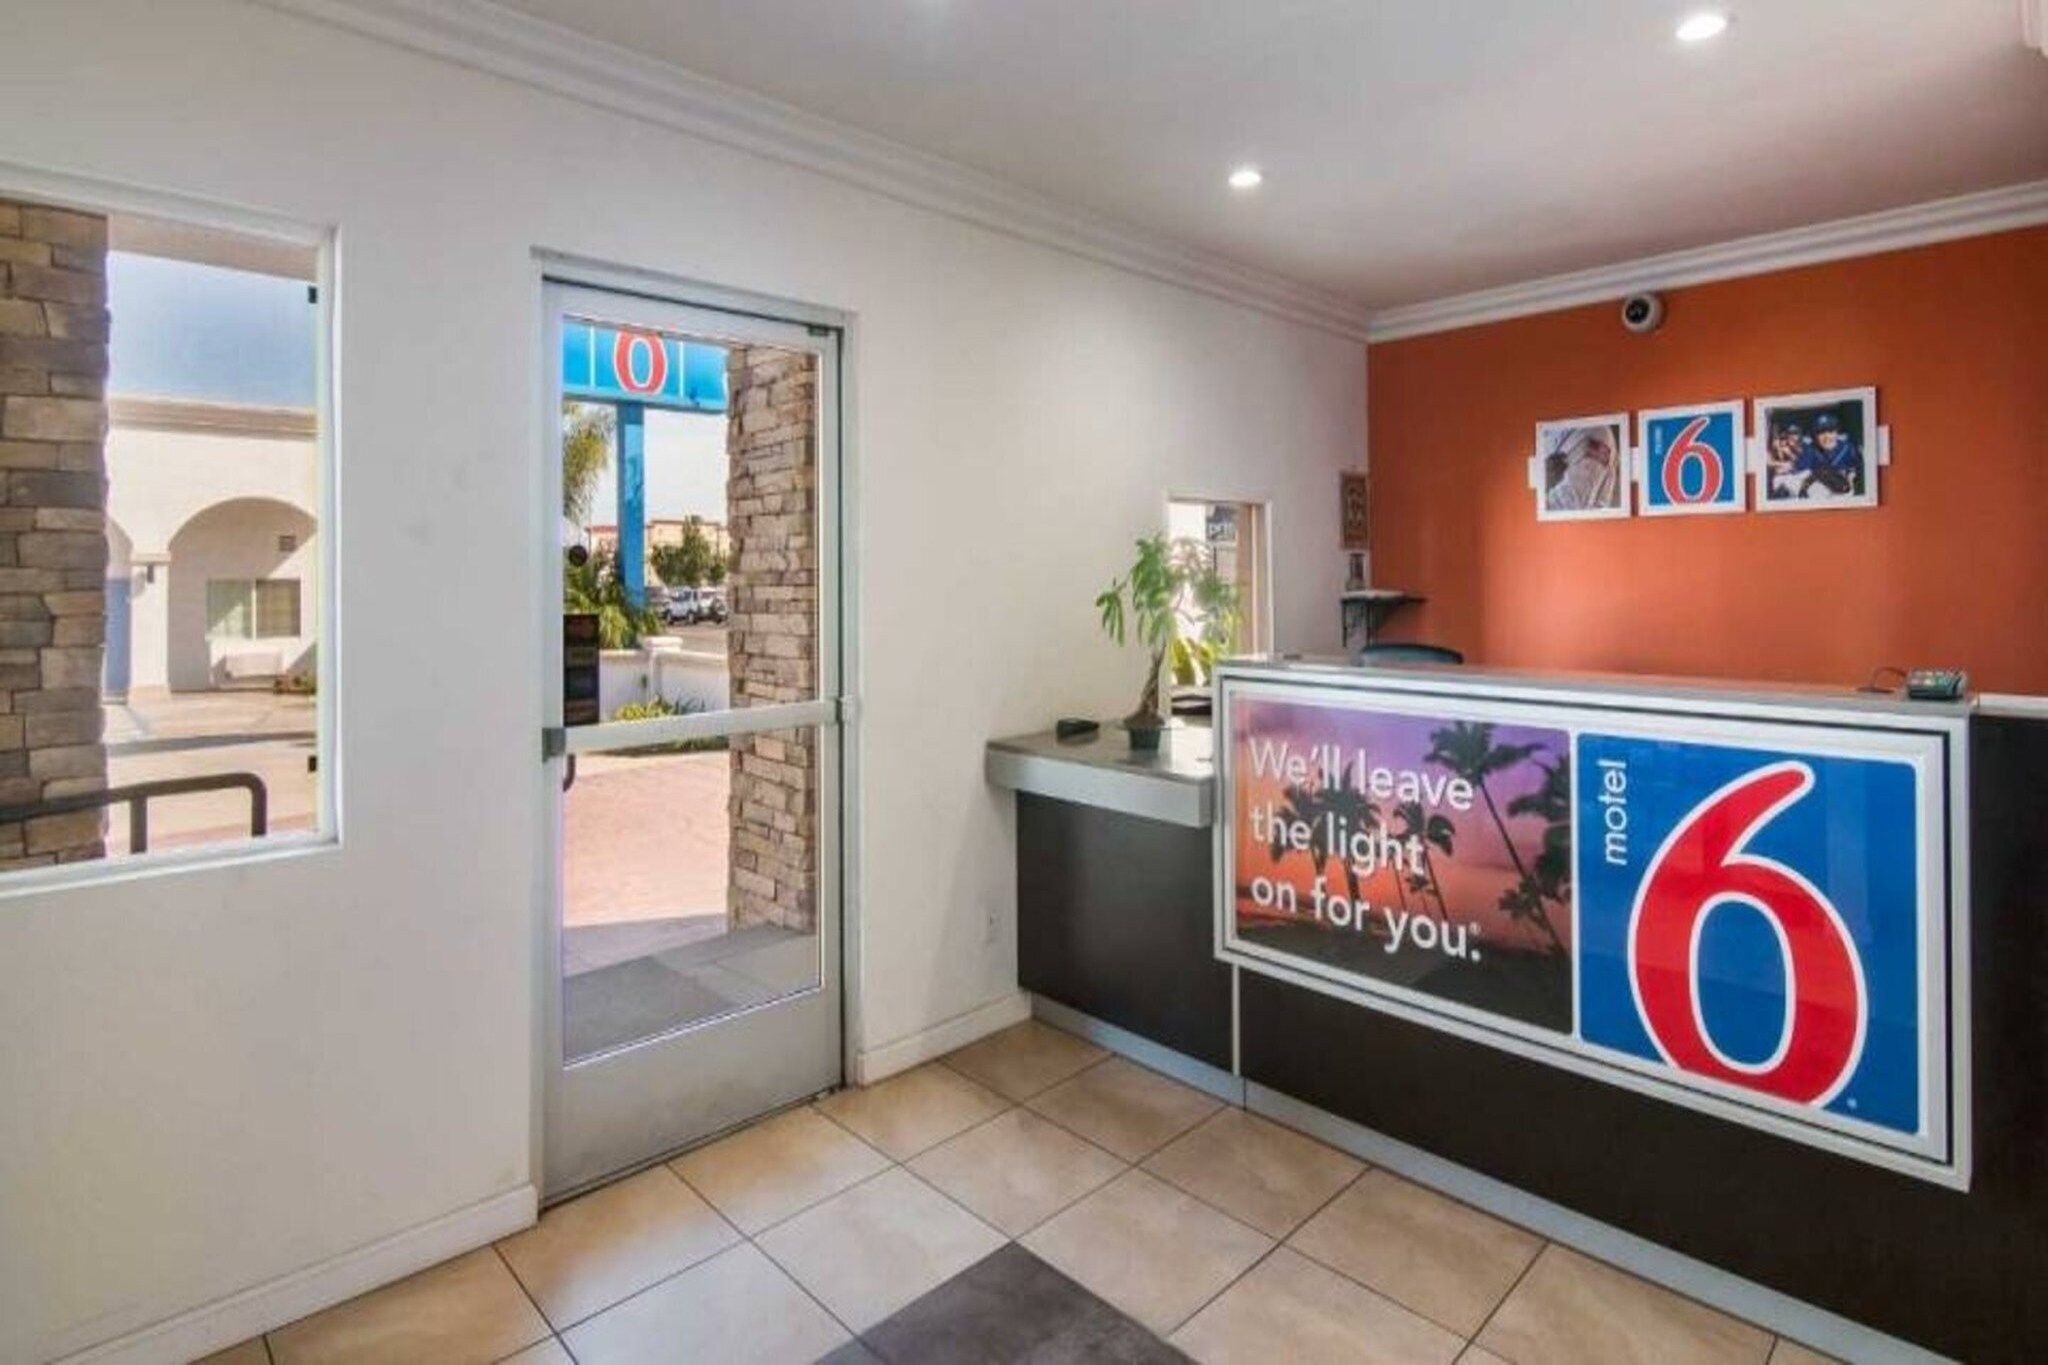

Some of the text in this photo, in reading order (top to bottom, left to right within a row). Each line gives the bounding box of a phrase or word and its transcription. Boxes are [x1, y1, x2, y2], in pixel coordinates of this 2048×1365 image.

[1661, 416, 1724, 505] 6
[1250, 737, 1474, 810] We'll leave
[1251, 801, 1425, 877] the light
[1251, 876, 1297, 914] on
[1311, 874, 1370, 931] for
[1597, 759, 1869, 1108] motel 6
